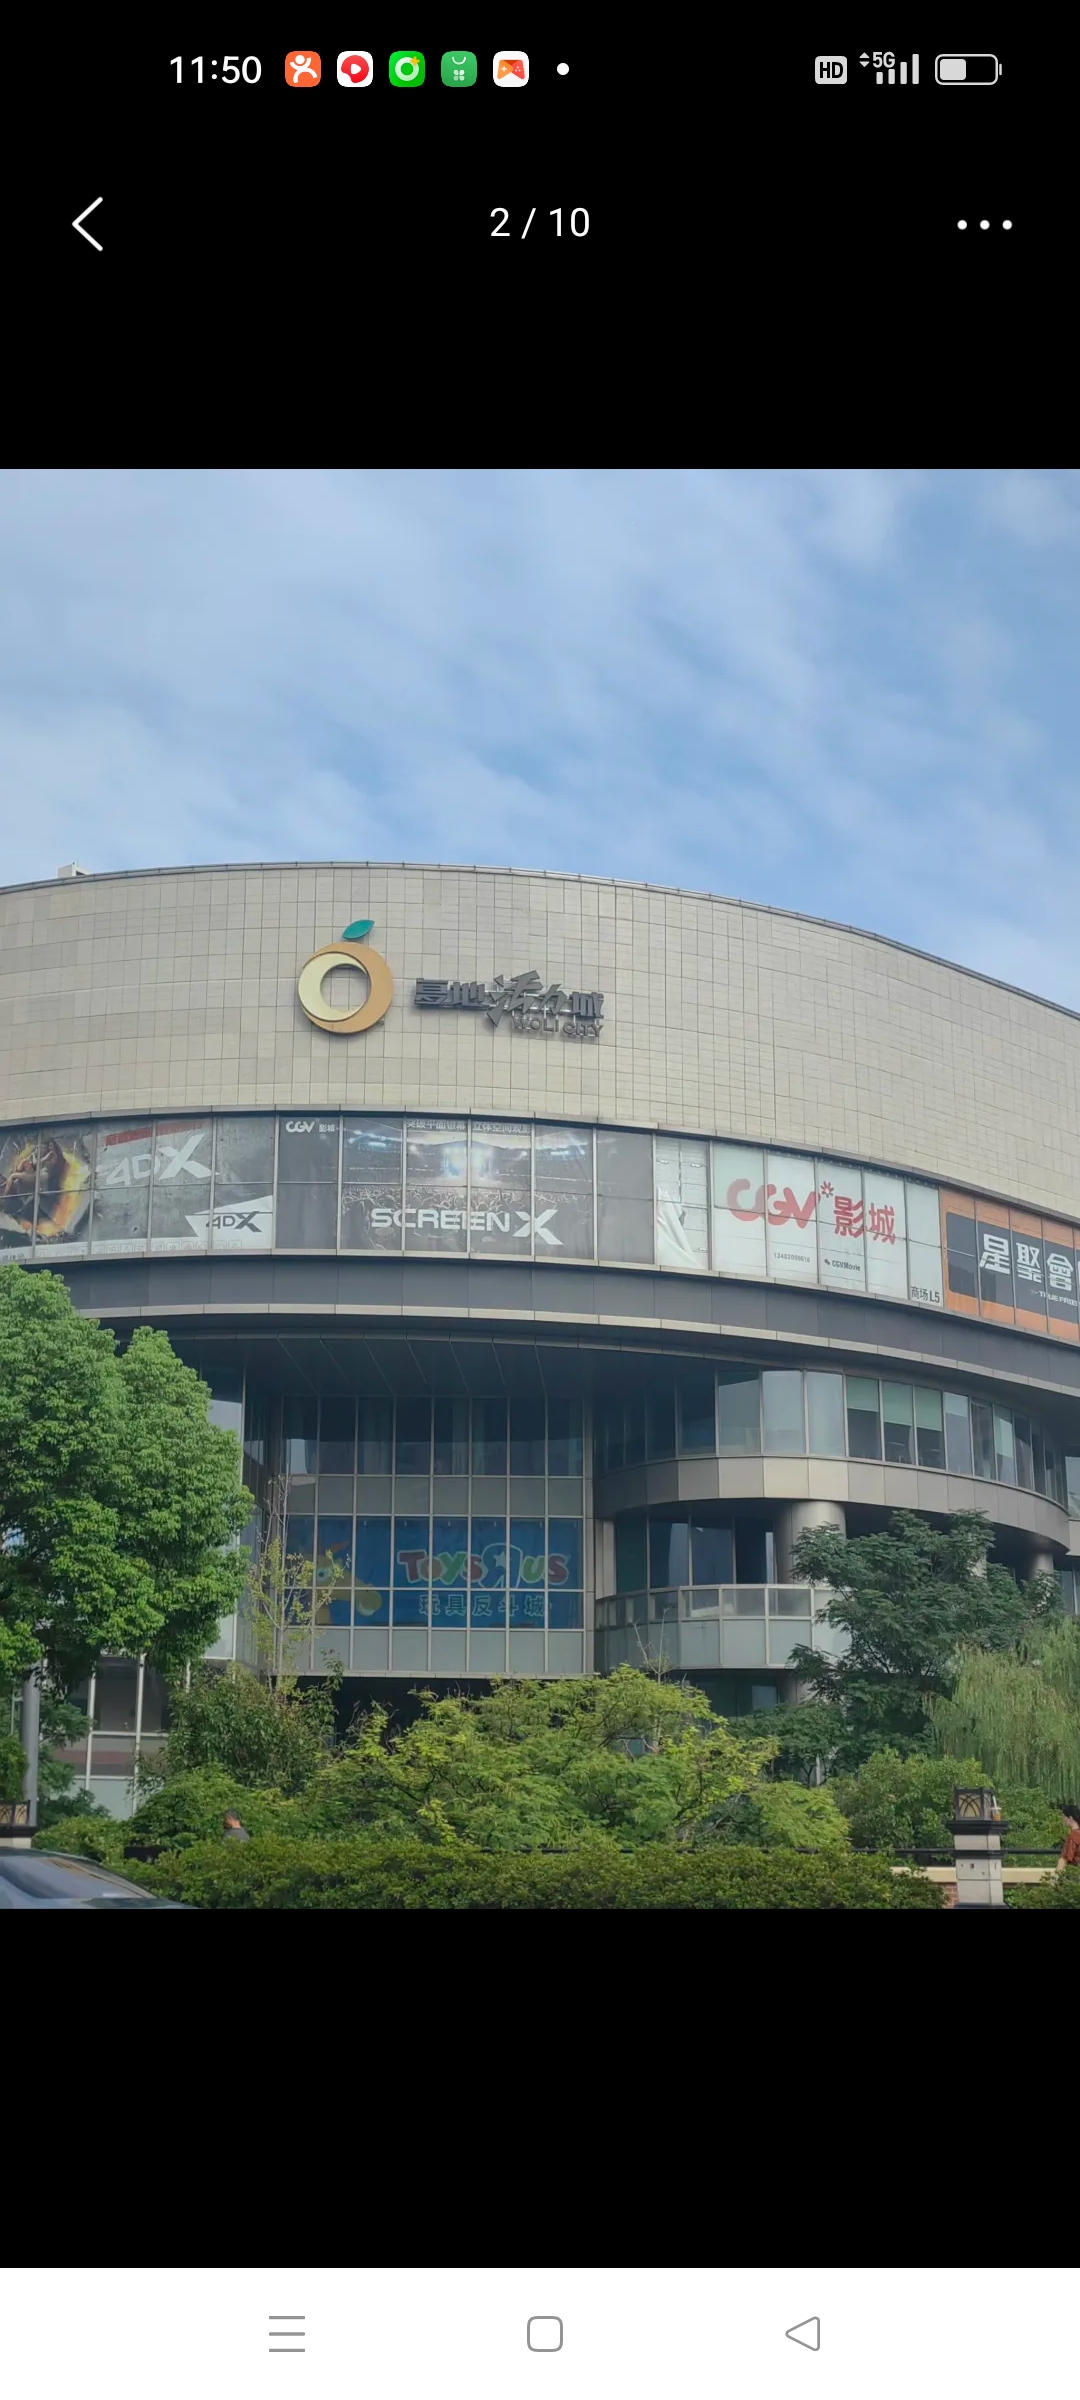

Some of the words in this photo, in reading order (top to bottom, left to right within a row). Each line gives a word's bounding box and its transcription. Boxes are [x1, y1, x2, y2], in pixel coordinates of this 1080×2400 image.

[511, 1016, 559, 1032] WOLI
[562, 1021, 604, 1037] CITY
[285, 1120, 315, 1133] CGV
[105, 1133, 220, 1186] 4DX
[205, 1210, 262, 1233] 4DX
[727, 1178, 822, 1229] CGV
[833, 1195, 896, 1245] 影城
[980, 1233, 1073, 1292] 星聚會
[419, 1594, 551, 1617] 玩具反斗城
